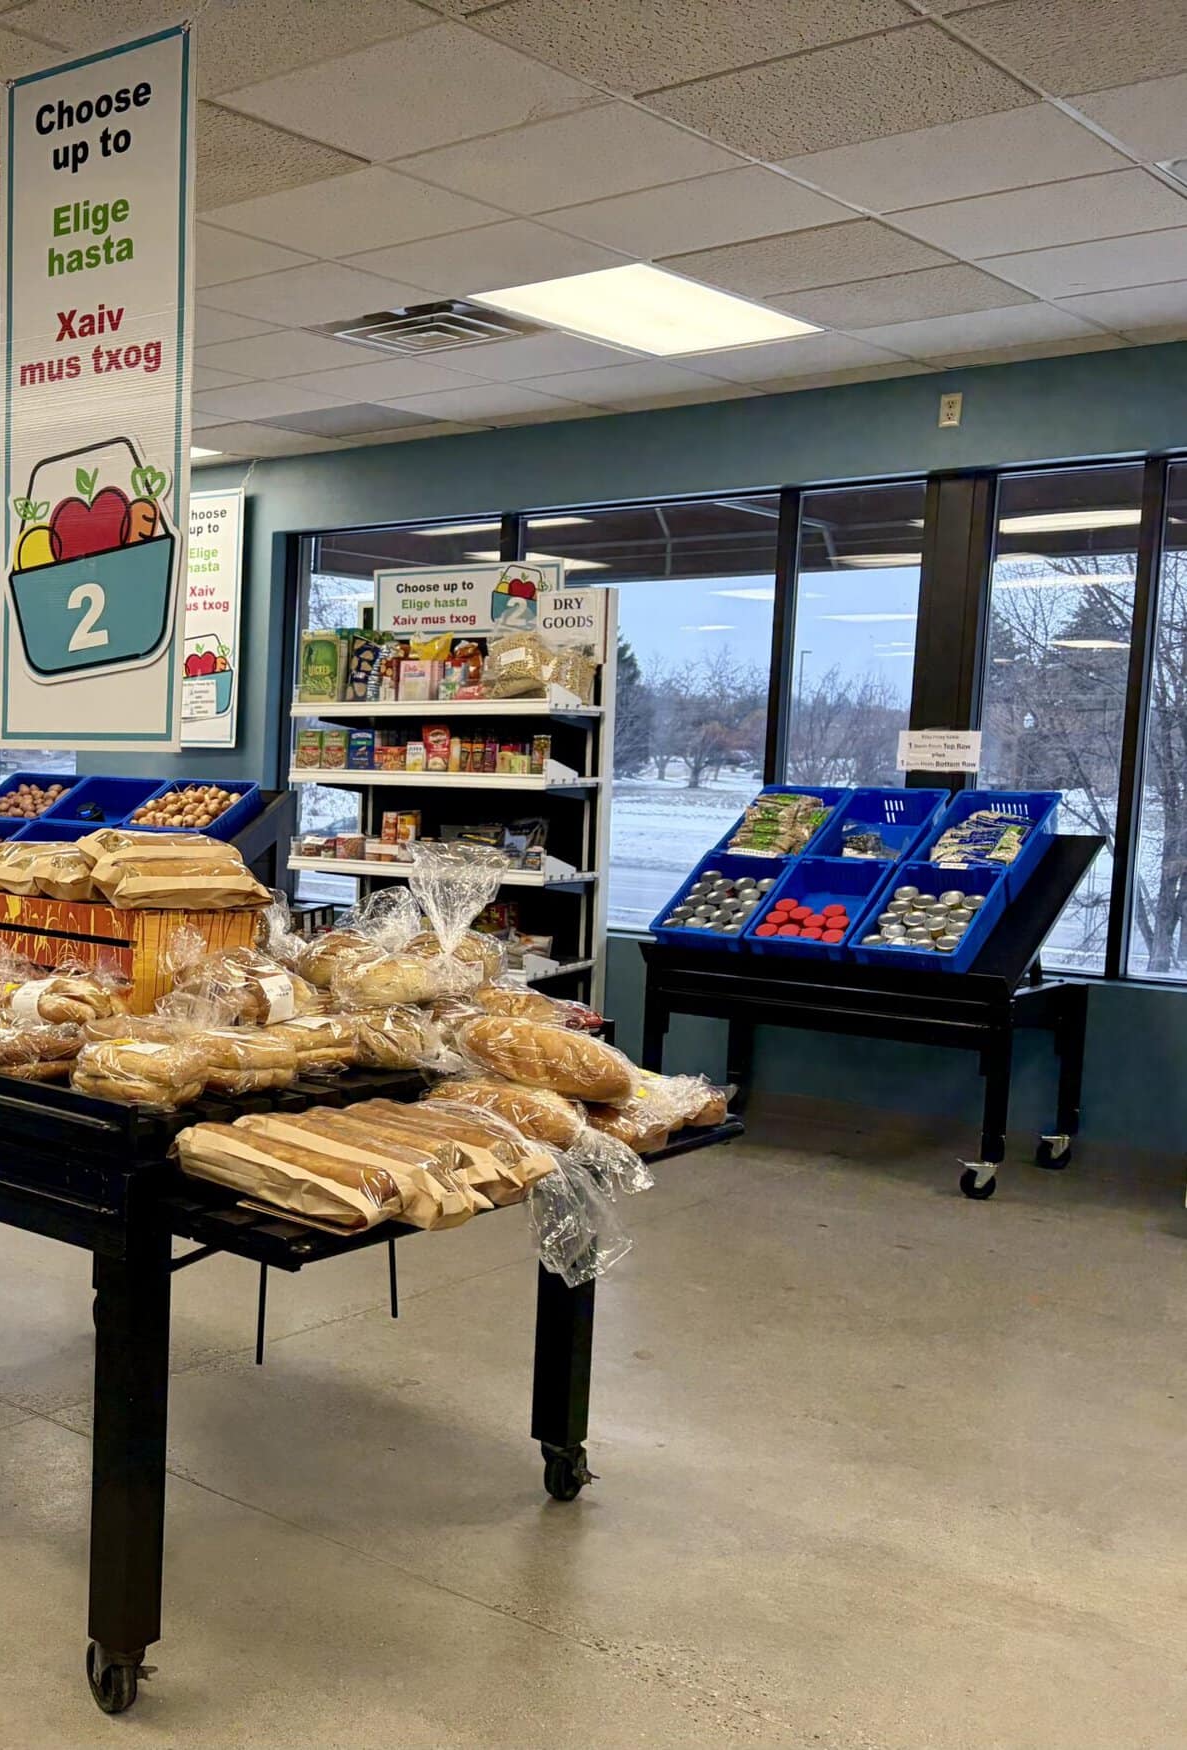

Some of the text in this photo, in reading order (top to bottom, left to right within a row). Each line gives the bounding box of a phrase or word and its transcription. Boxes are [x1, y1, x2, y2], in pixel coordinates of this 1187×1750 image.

[35, 81, 152, 135] Choose
[52, 126, 132, 173] up to
[53, 198, 130, 236] Elige
[47, 236, 134, 277] hasta
[55, 303, 125, 342] Xaiv
[19, 339, 163, 387] mus txog
[191, 508, 228, 521] hoose
[189, 522, 220, 537] up to
[189, 547, 219, 560] Elige
[189, 584, 216, 597] Xaiv
[395, 580, 474, 595] Choose up to
[185, 600, 230, 613] us txog
[401, 597, 468, 610] Elige hasta
[552, 597, 584, 610] DRY
[67, 582, 109, 653] 2
[392, 613, 477, 626] Xaiv mus txog
[505, 598, 529, 626] 2
[542, 615, 594, 629] GOODS
